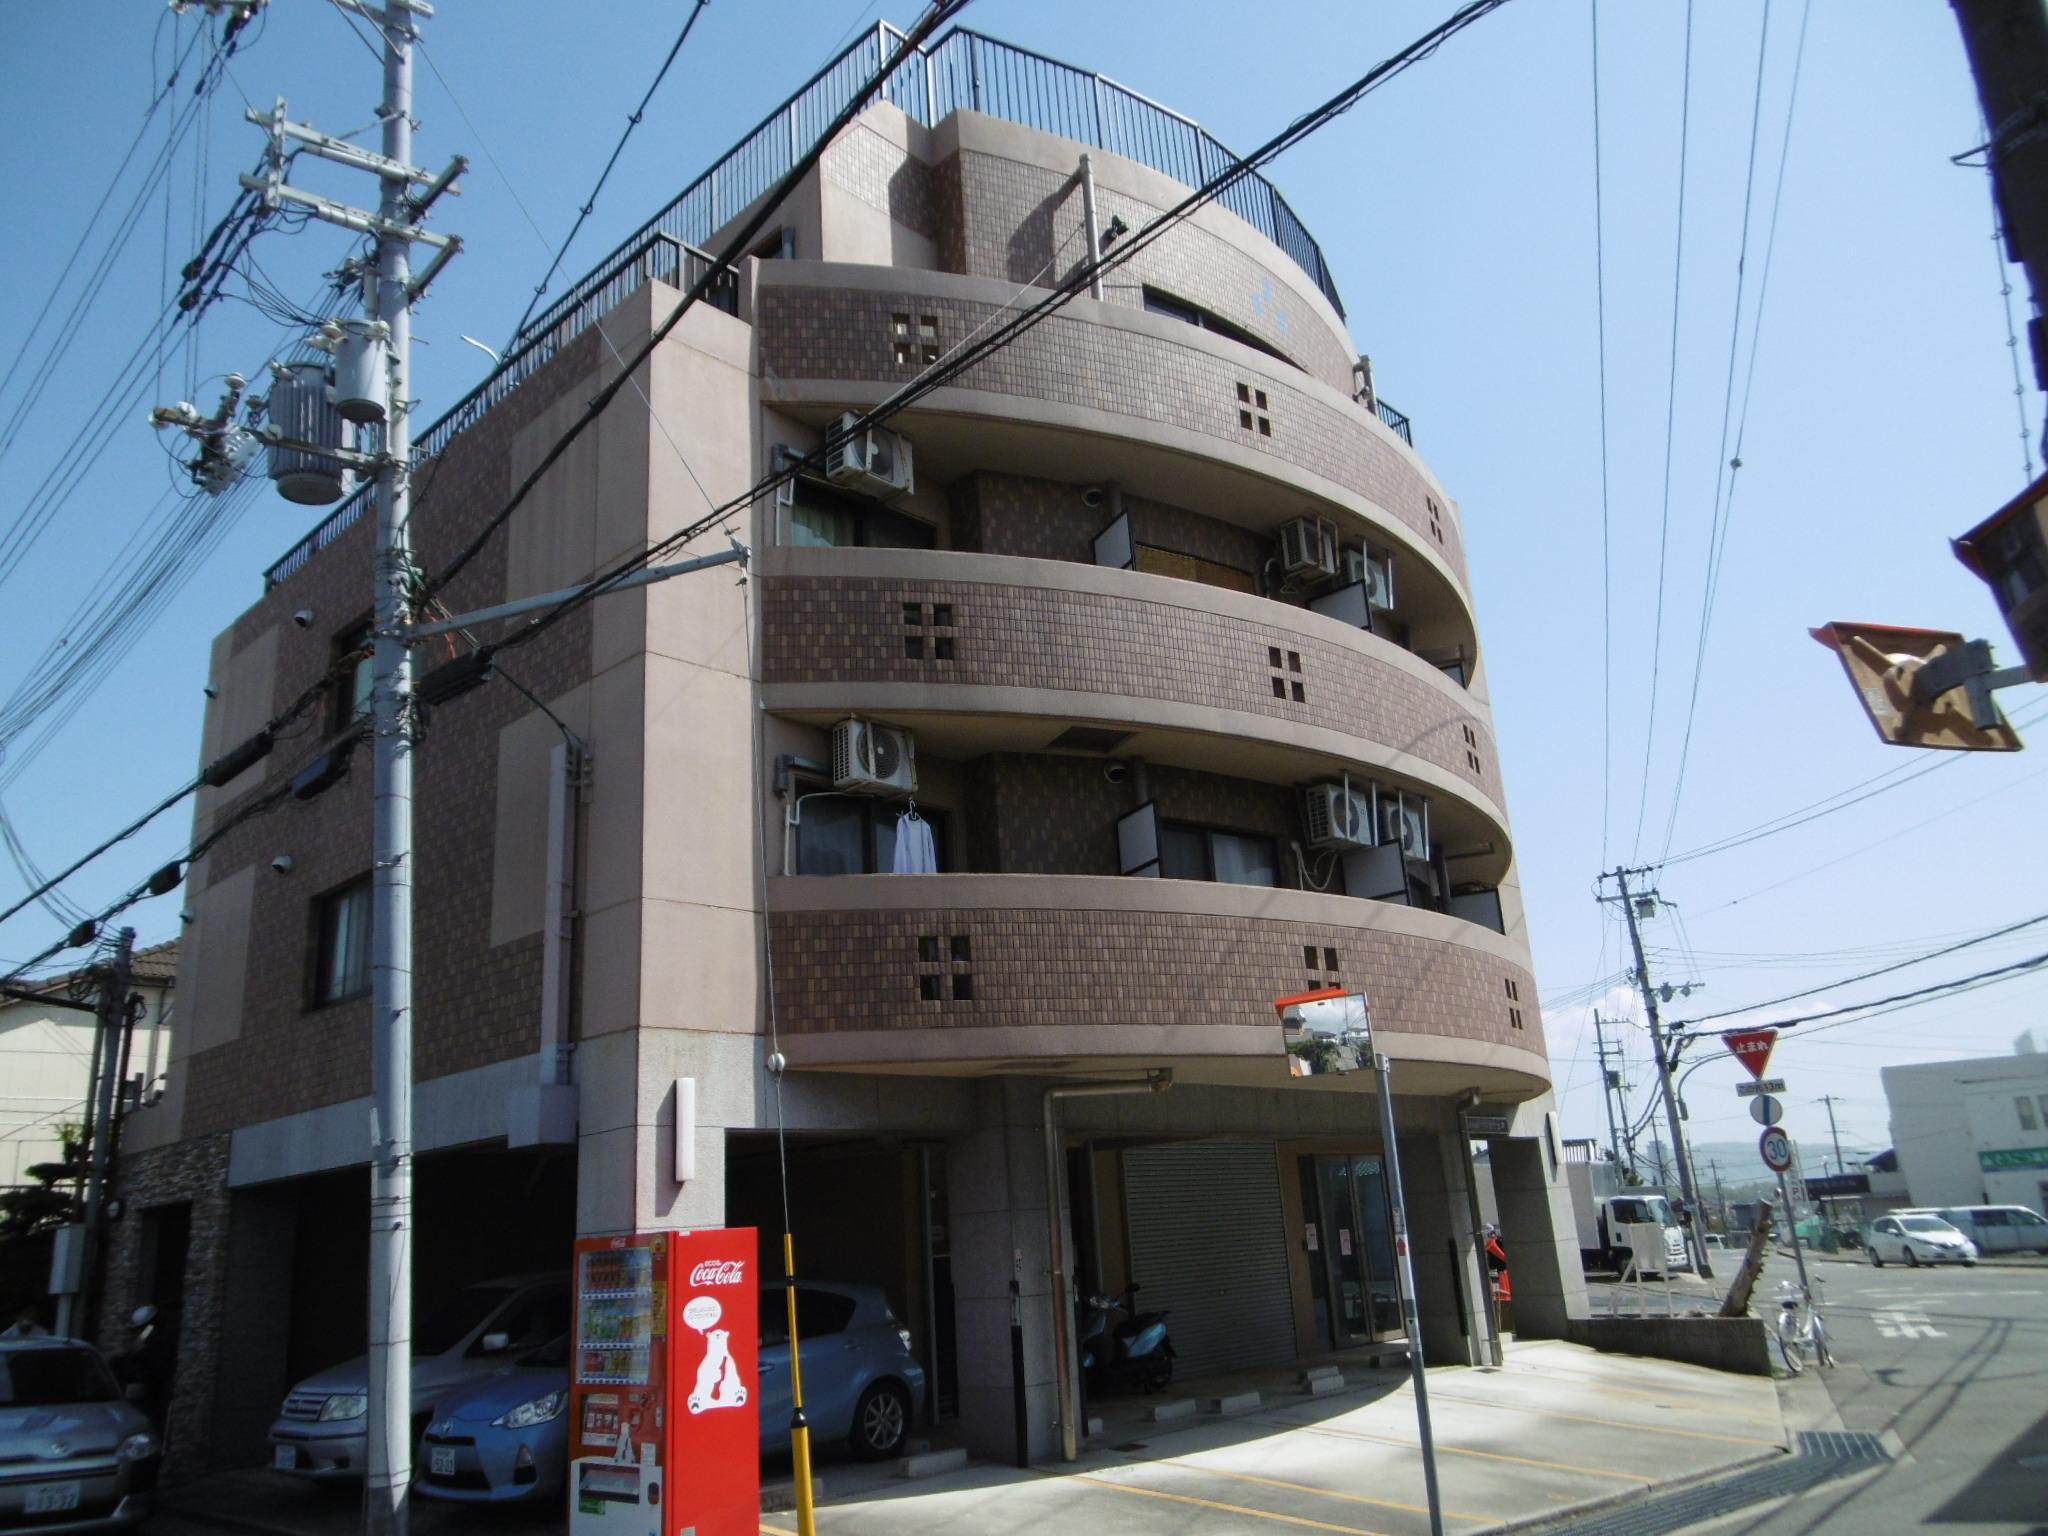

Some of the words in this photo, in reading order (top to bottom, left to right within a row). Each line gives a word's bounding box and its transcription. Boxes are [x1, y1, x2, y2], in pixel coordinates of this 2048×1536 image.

[1735, 1040, 1769, 1054] 止まれ
[1767, 1139, 1786, 1160] 30
[690, 1261, 745, 1287] Coca-Cola
